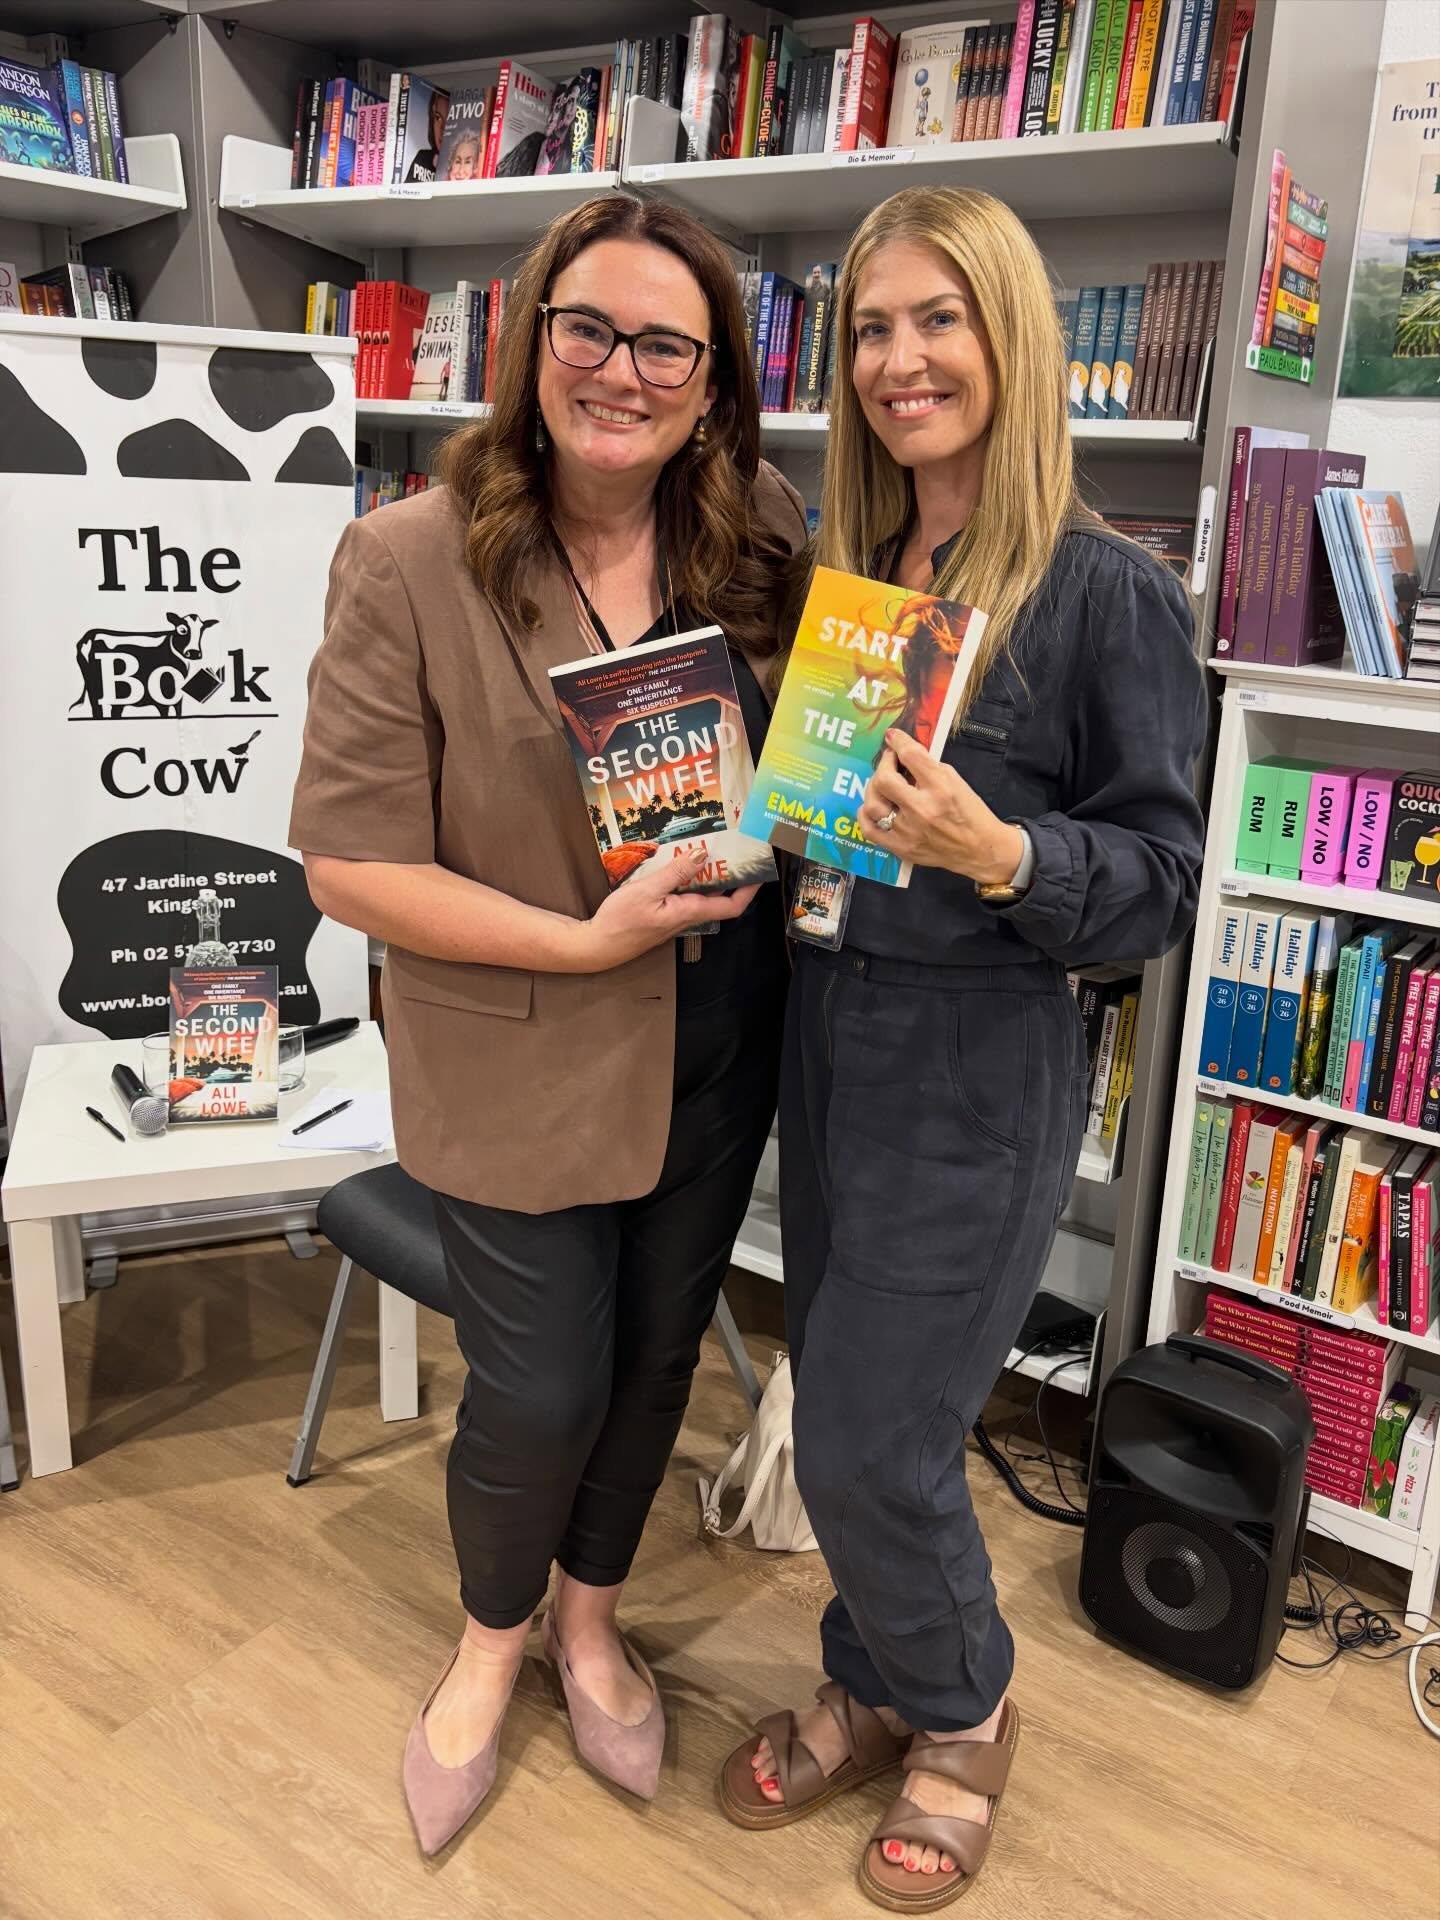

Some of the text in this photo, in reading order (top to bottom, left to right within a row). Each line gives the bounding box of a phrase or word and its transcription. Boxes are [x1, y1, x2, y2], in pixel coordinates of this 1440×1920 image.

[1033, 19, 1055, 67] LUCKY
[1140, 1, 1159, 72] NOT MY TYPE
[1177, 22, 1192, 63] BUNNINGS
[1174, 64, 1185, 83] MAN
[759, 60, 776, 142] BONNIE CLYDE
[1392, 104, 1437, 121] from
[757, 281, 772, 340] OUT OF THE BLUE
[808, 301, 825, 390] PETER FITZSIMONS
[1198, 518, 1210, 562] Beverage
[1254, 501, 1275, 594] James Halliday
[1286, 503, 1309, 598] James Halliday
[78, 526, 241, 593] The
[818, 616, 909, 663] START
[631, 663, 653, 673] moving
[666, 656, 676, 664] the
[676, 648, 708, 662] footprints
[660, 660, 694, 673] AUSTRALIAN
[617, 685, 683, 708] ONE INHERITANCE
[627, 679, 670, 696] ONE FAMILY
[846, 675, 889, 707] AT
[626, 697, 678, 715] SIX SUSPECTS
[634, 713, 680, 739] THE
[803, 706, 857, 750] THE
[587, 722, 738, 784] SECOND
[100, 747, 249, 799] Cow
[624, 758, 717, 806] WIFE
[767, 791, 827, 829] EMMA
[1249, 795, 1265, 833] RUM
[1281, 800, 1298, 839] RUM
[1317, 787, 1334, 826] LOW
[1362, 791, 1380, 830] LOW
[764, 811, 799, 828] BESTSELLING
[800, 825, 824, 838] AUTHOR
[834, 836, 864, 851] PICTURES
[875, 850, 889, 858] YOU
[1312, 839, 1327, 864] NO
[1357, 844, 1372, 869] NO
[101, 870, 277, 892] 47 Jardine Street
[818, 872, 830, 880] THE
[111, 949, 137, 963] Ph
[143, 947, 168, 961] 02
[227, 939, 276, 954] 2730
[1219, 917, 1238, 967] Halliday
[1249, 922, 1268, 973] Halliday
[1282, 927, 1302, 978] Halliday
[1217, 987, 1228, 995] 20
[1217, 997, 1227, 1005] 26
[1247, 993, 1258, 1001] 20
[1280, 1000, 1291, 1008] 20
[175, 1017, 272, 1036] SECOND
[210, 1004, 238, 1016] THE
[1105, 1012, 1114, 1035] MURDER
[1279, 1010, 1290, 1018] 26
[1402, 981, 1420, 1045] FREE THE TIPPLE
[1421, 985, 1440, 1049] FREE THE TIPPLE
[195, 1036, 254, 1055] WIFE
[1116, 1007, 1131, 1073] The Running Ground
[1099, 1056, 1109, 1078] STREET
[202, 1101, 248, 1115] LOWE
[212, 1086, 237, 1099] ALI
[1311, 1180, 1319, 1199] Indian
[1345, 1177, 1361, 1229] FRANCESCA
[1356, 1194, 1368, 1217] DEAR
[1264, 1190, 1278, 1235] NUTRITION
[1397, 1193, 1410, 1239] TAPAS
[1213, 1303, 1227, 1312] She
[1228, 1306, 1245, 1317] Who
[1279, 1297, 1333, 1321] Food Memoir
